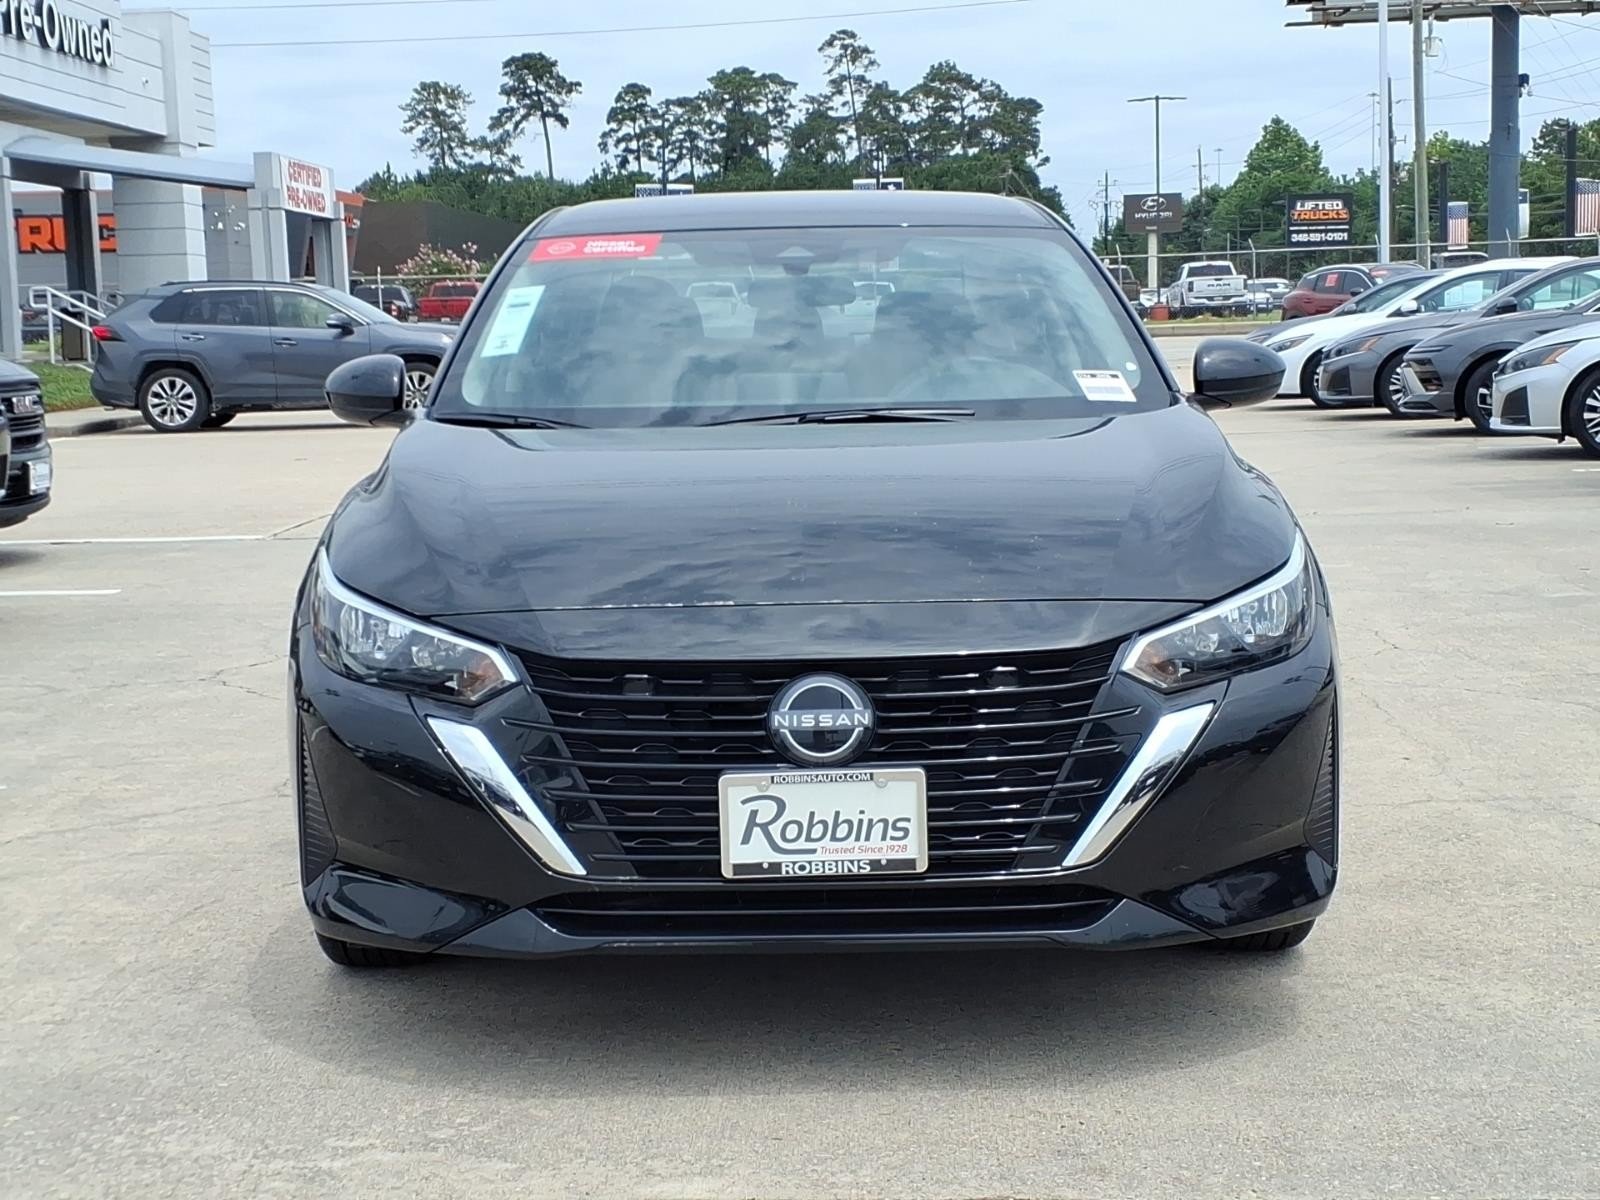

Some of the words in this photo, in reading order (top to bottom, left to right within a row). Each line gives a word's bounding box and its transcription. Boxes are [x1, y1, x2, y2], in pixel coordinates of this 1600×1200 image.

[287, 159, 322, 188] CERTIFIED
[286, 185, 326, 213] PRE-OWNED
[1296, 200, 1343, 210] LIFTED
[1291, 209, 1348, 220] TRUCKS
[774, 712, 869, 728] NISSAN
[773, 772, 871, 784] ROBBINSAUTO.COM
[739, 794, 912, 855] Robbins
[820, 846, 855, 855] Trusted
[857, 845, 883, 854] Since
[886, 844, 908, 854] 1928
[781, 859, 871, 875] ROBBINS
